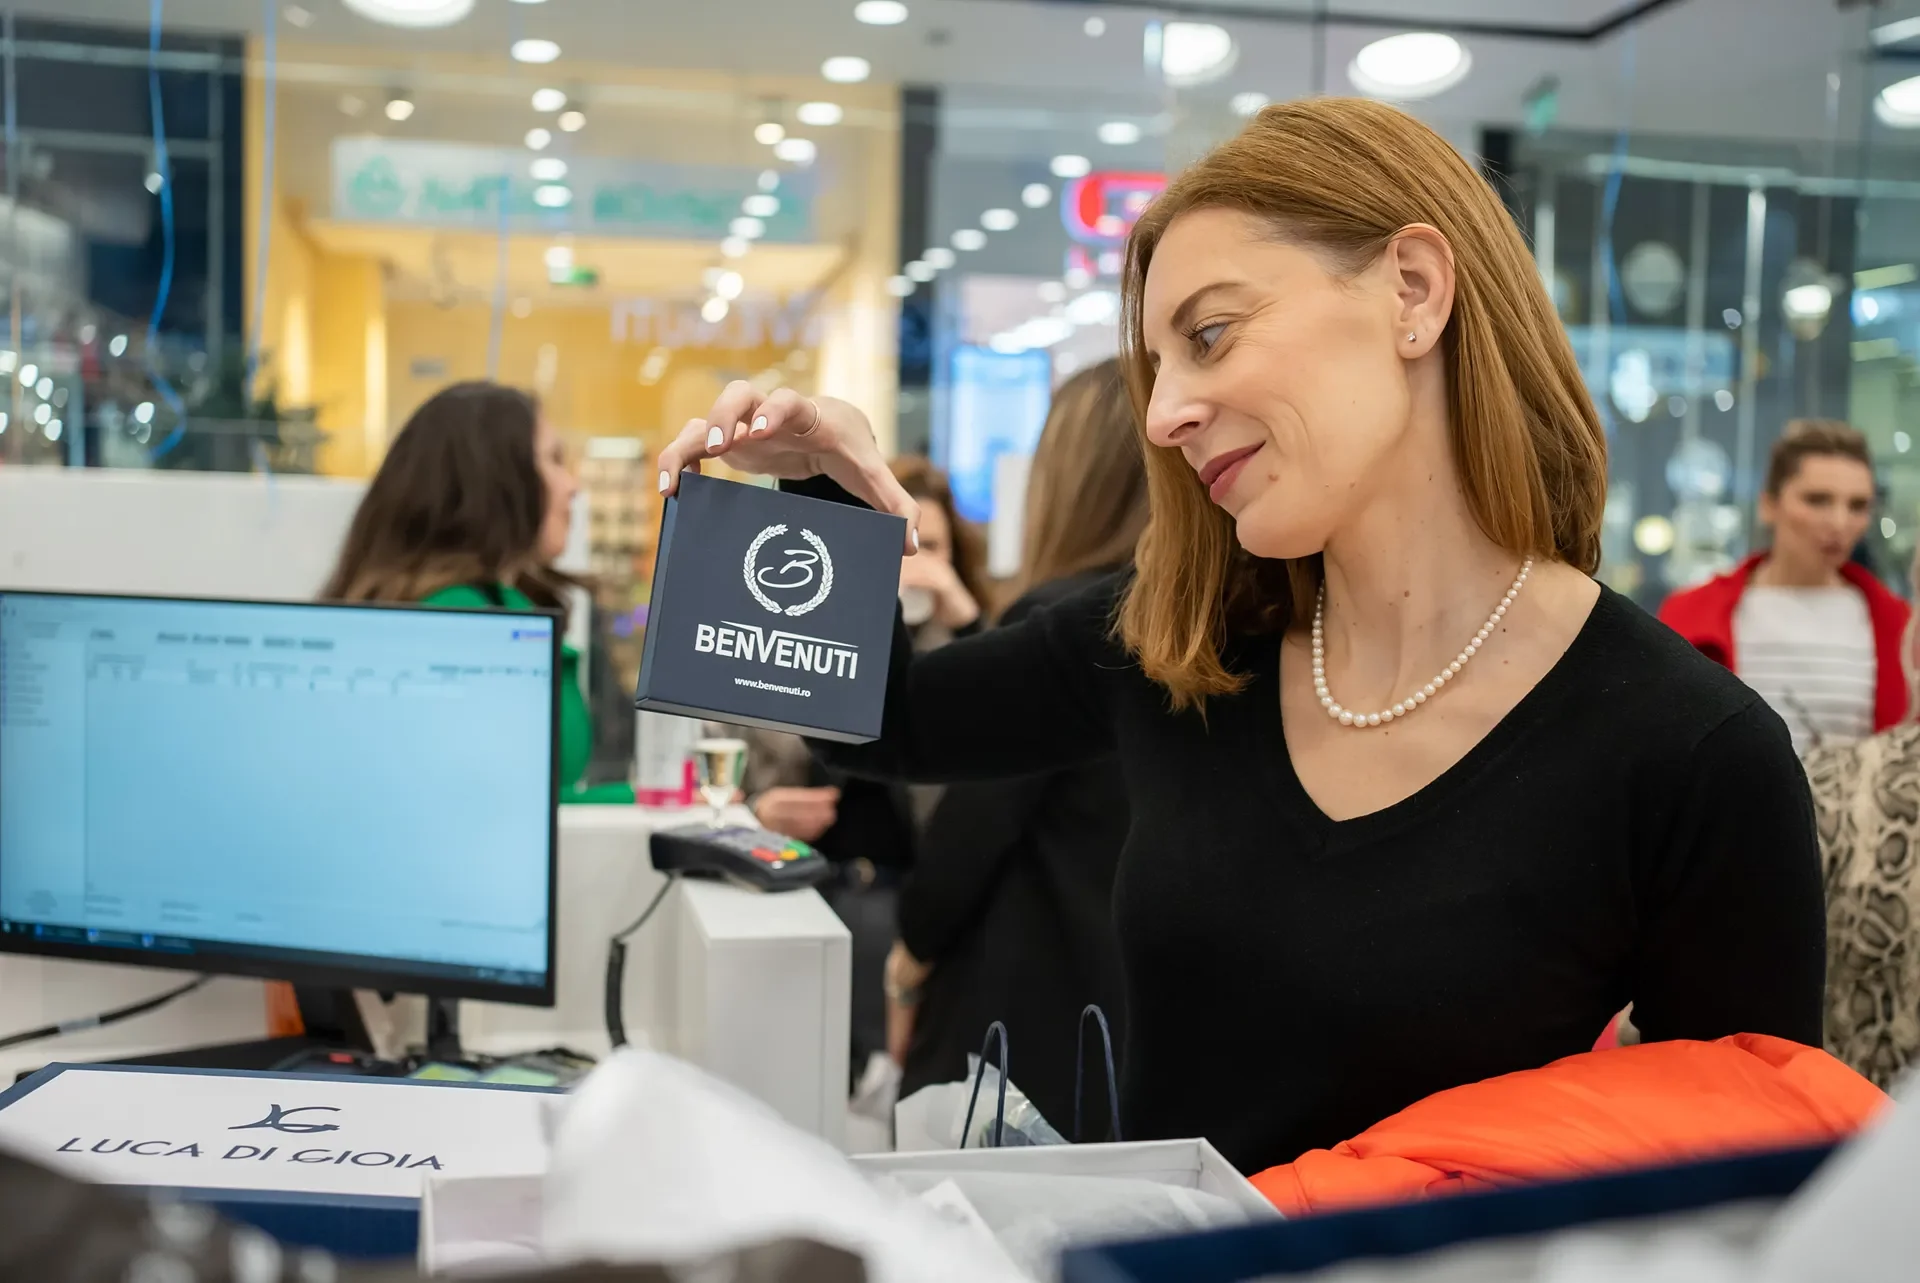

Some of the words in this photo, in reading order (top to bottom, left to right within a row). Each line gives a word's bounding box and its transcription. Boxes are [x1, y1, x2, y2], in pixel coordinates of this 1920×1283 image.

[694, 620, 859, 680] BENVENUTI
[734, 677, 811, 698] www.benvenuti.ro
[56, 1137, 204, 1158] LUCA
[221, 1145, 279, 1161] DI
[286, 1148, 445, 1171] GIOIA
